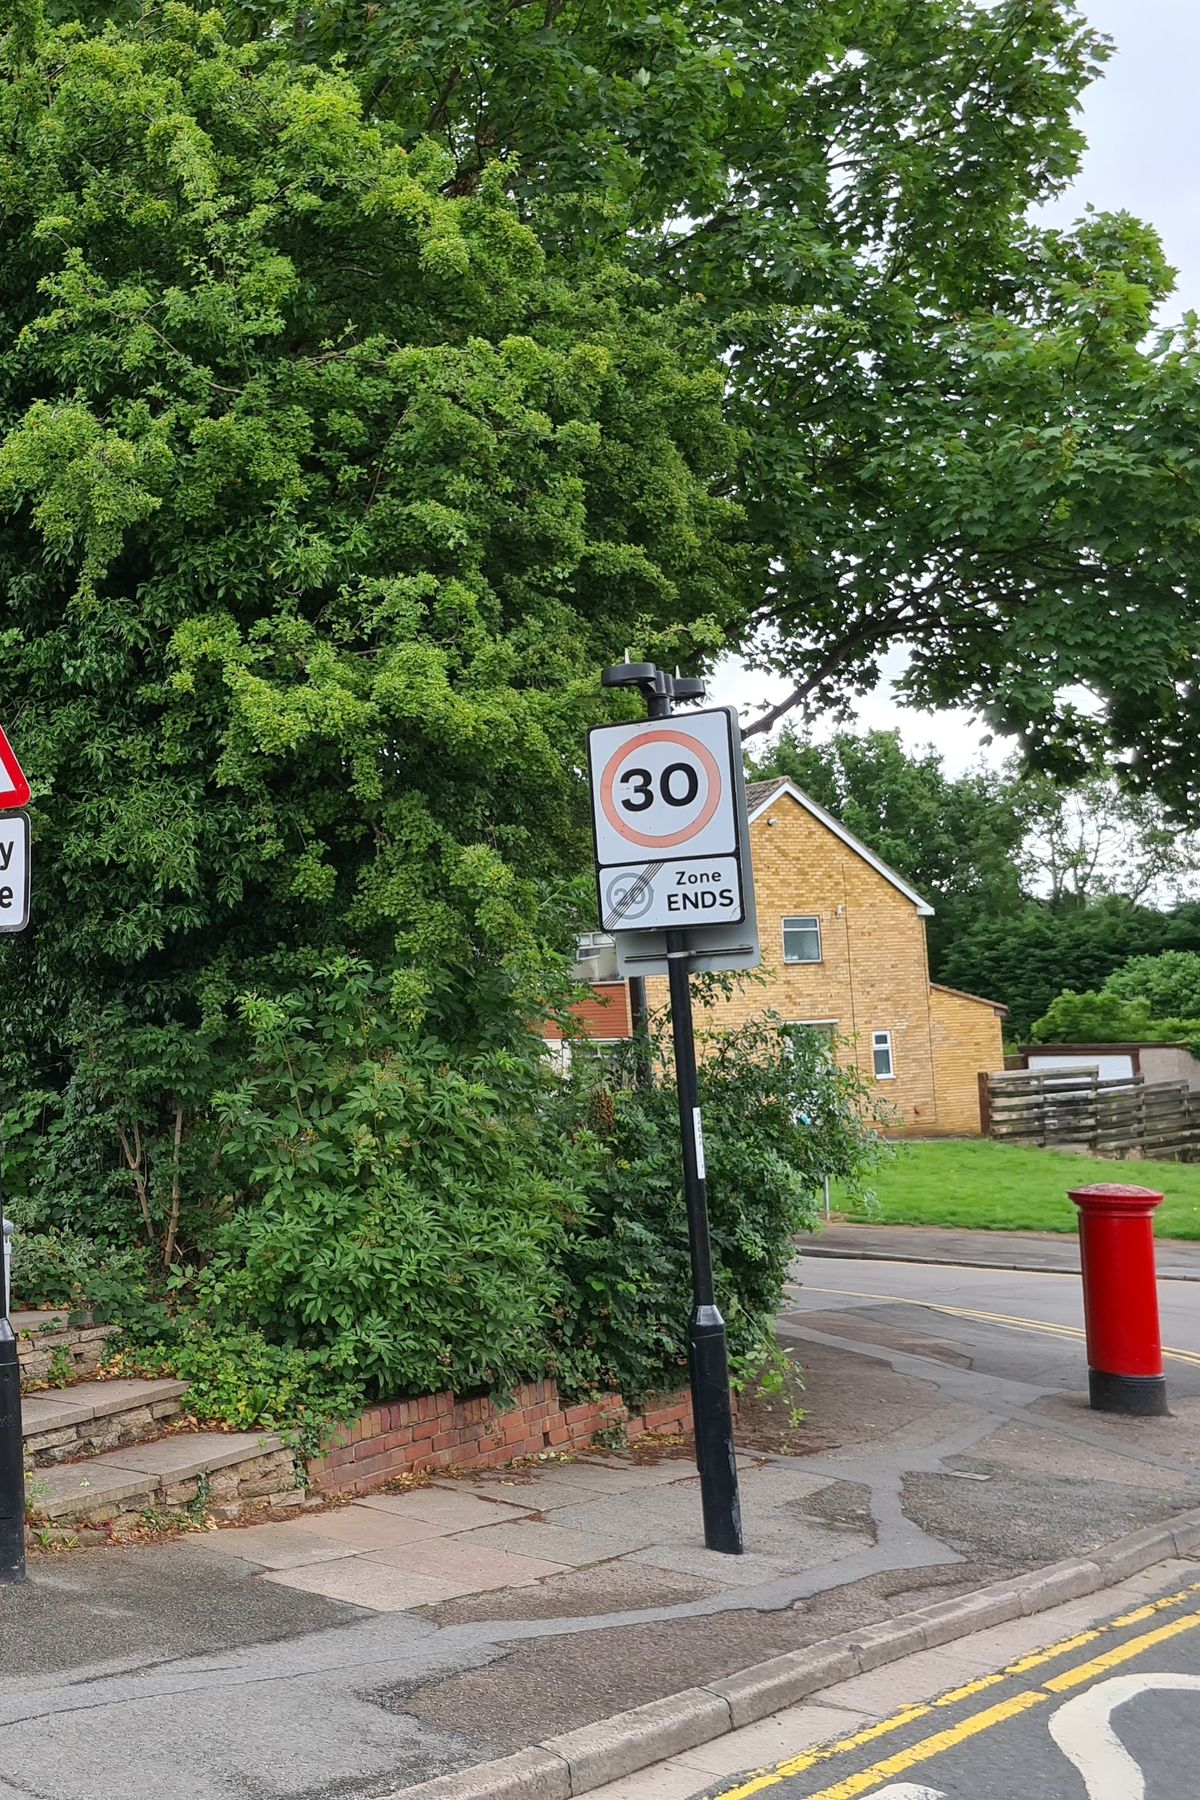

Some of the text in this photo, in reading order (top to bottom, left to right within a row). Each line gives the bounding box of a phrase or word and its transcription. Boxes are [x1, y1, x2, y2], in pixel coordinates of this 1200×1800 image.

[620, 762, 699, 812] 30
[675, 871, 722, 885] Zone
[667, 889, 734, 911] ENDS
